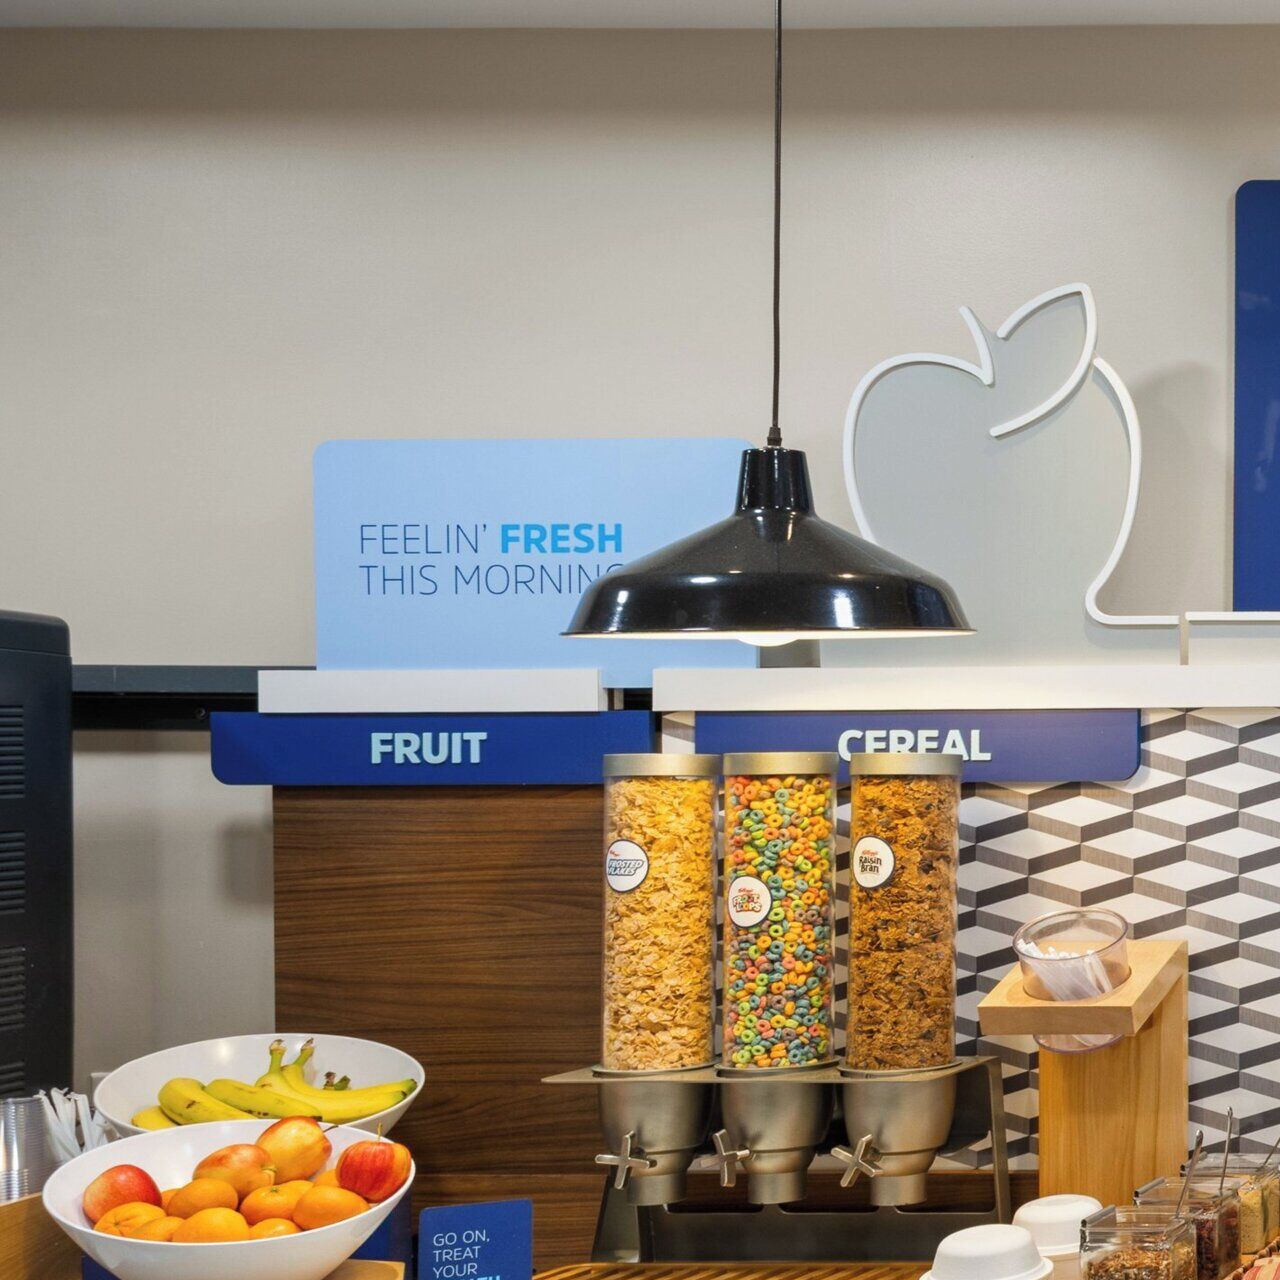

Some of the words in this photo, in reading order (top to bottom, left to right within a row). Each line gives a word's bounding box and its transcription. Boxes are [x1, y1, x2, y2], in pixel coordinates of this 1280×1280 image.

[500, 522, 624, 554] FRESH
[359, 564, 439, 596] THIS
[453, 563, 624, 596] MORNIN
[370, 732, 488, 765] FRUIT
[838, 729, 992, 762] CEREAL
[859, 856, 882, 866] Raisin
[861, 864, 879, 873] Bran
[433, 1232, 457, 1247] GO
[433, 1246, 481, 1262] TREAT
[433, 1263, 478, 1279] YOUR
